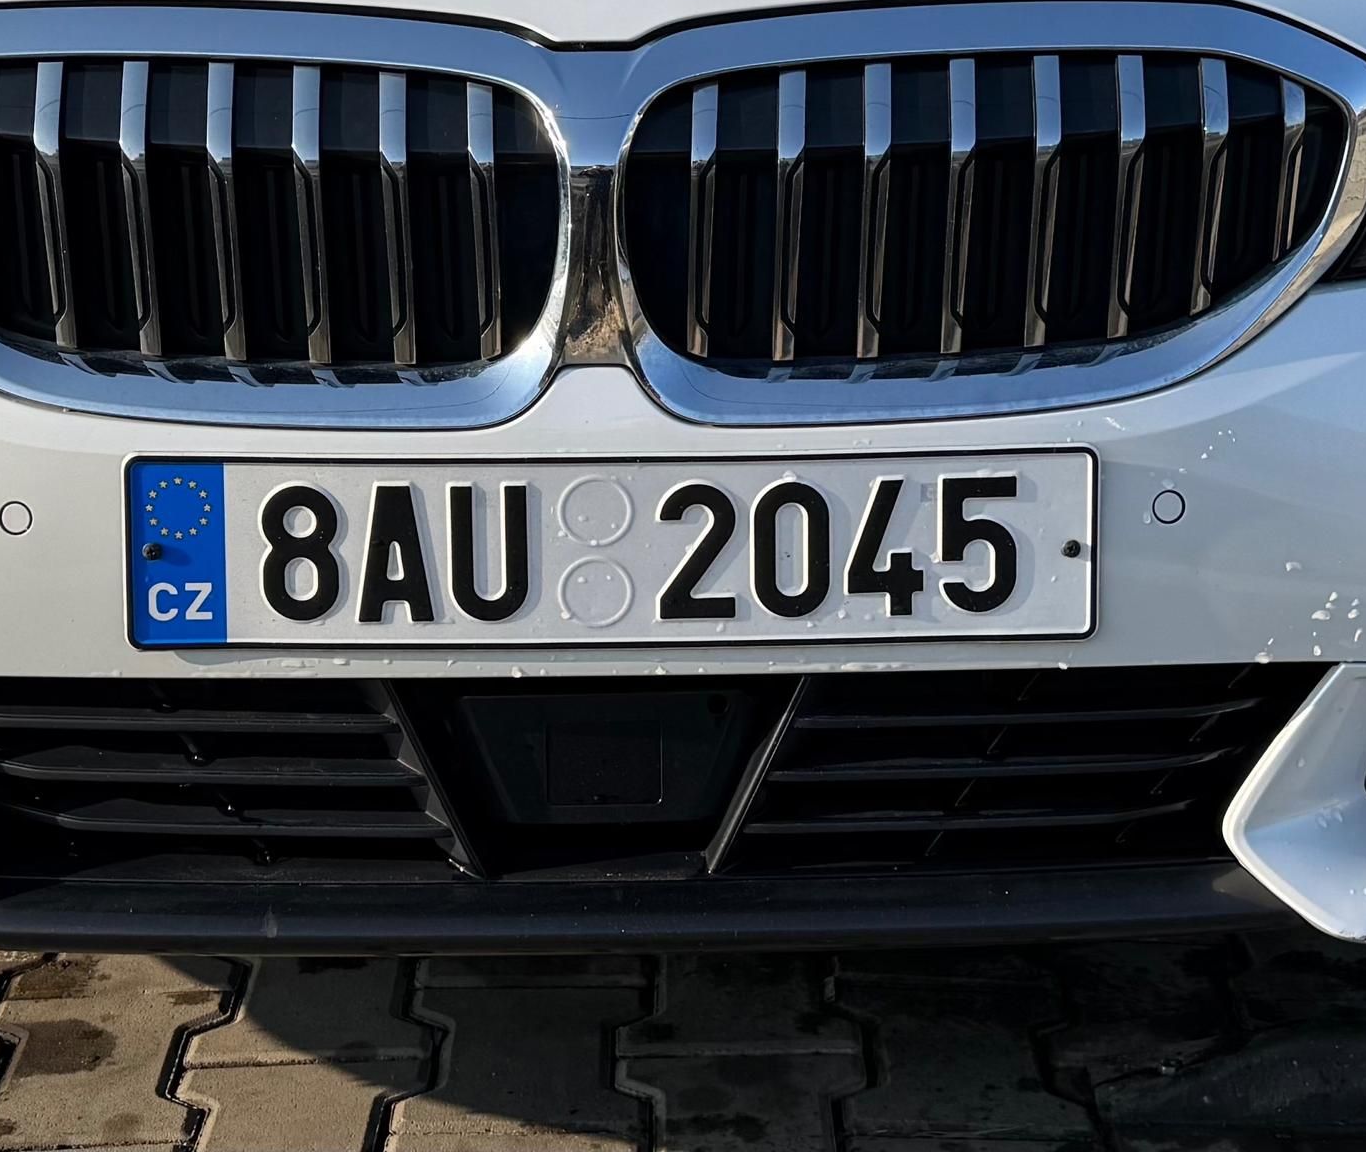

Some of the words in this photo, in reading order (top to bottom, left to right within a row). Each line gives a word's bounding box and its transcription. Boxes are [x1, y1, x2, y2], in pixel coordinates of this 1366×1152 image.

[259, 484, 528, 625] 8AU
[658, 474, 1019, 621] 2045
[147, 581, 214, 622] CZ
